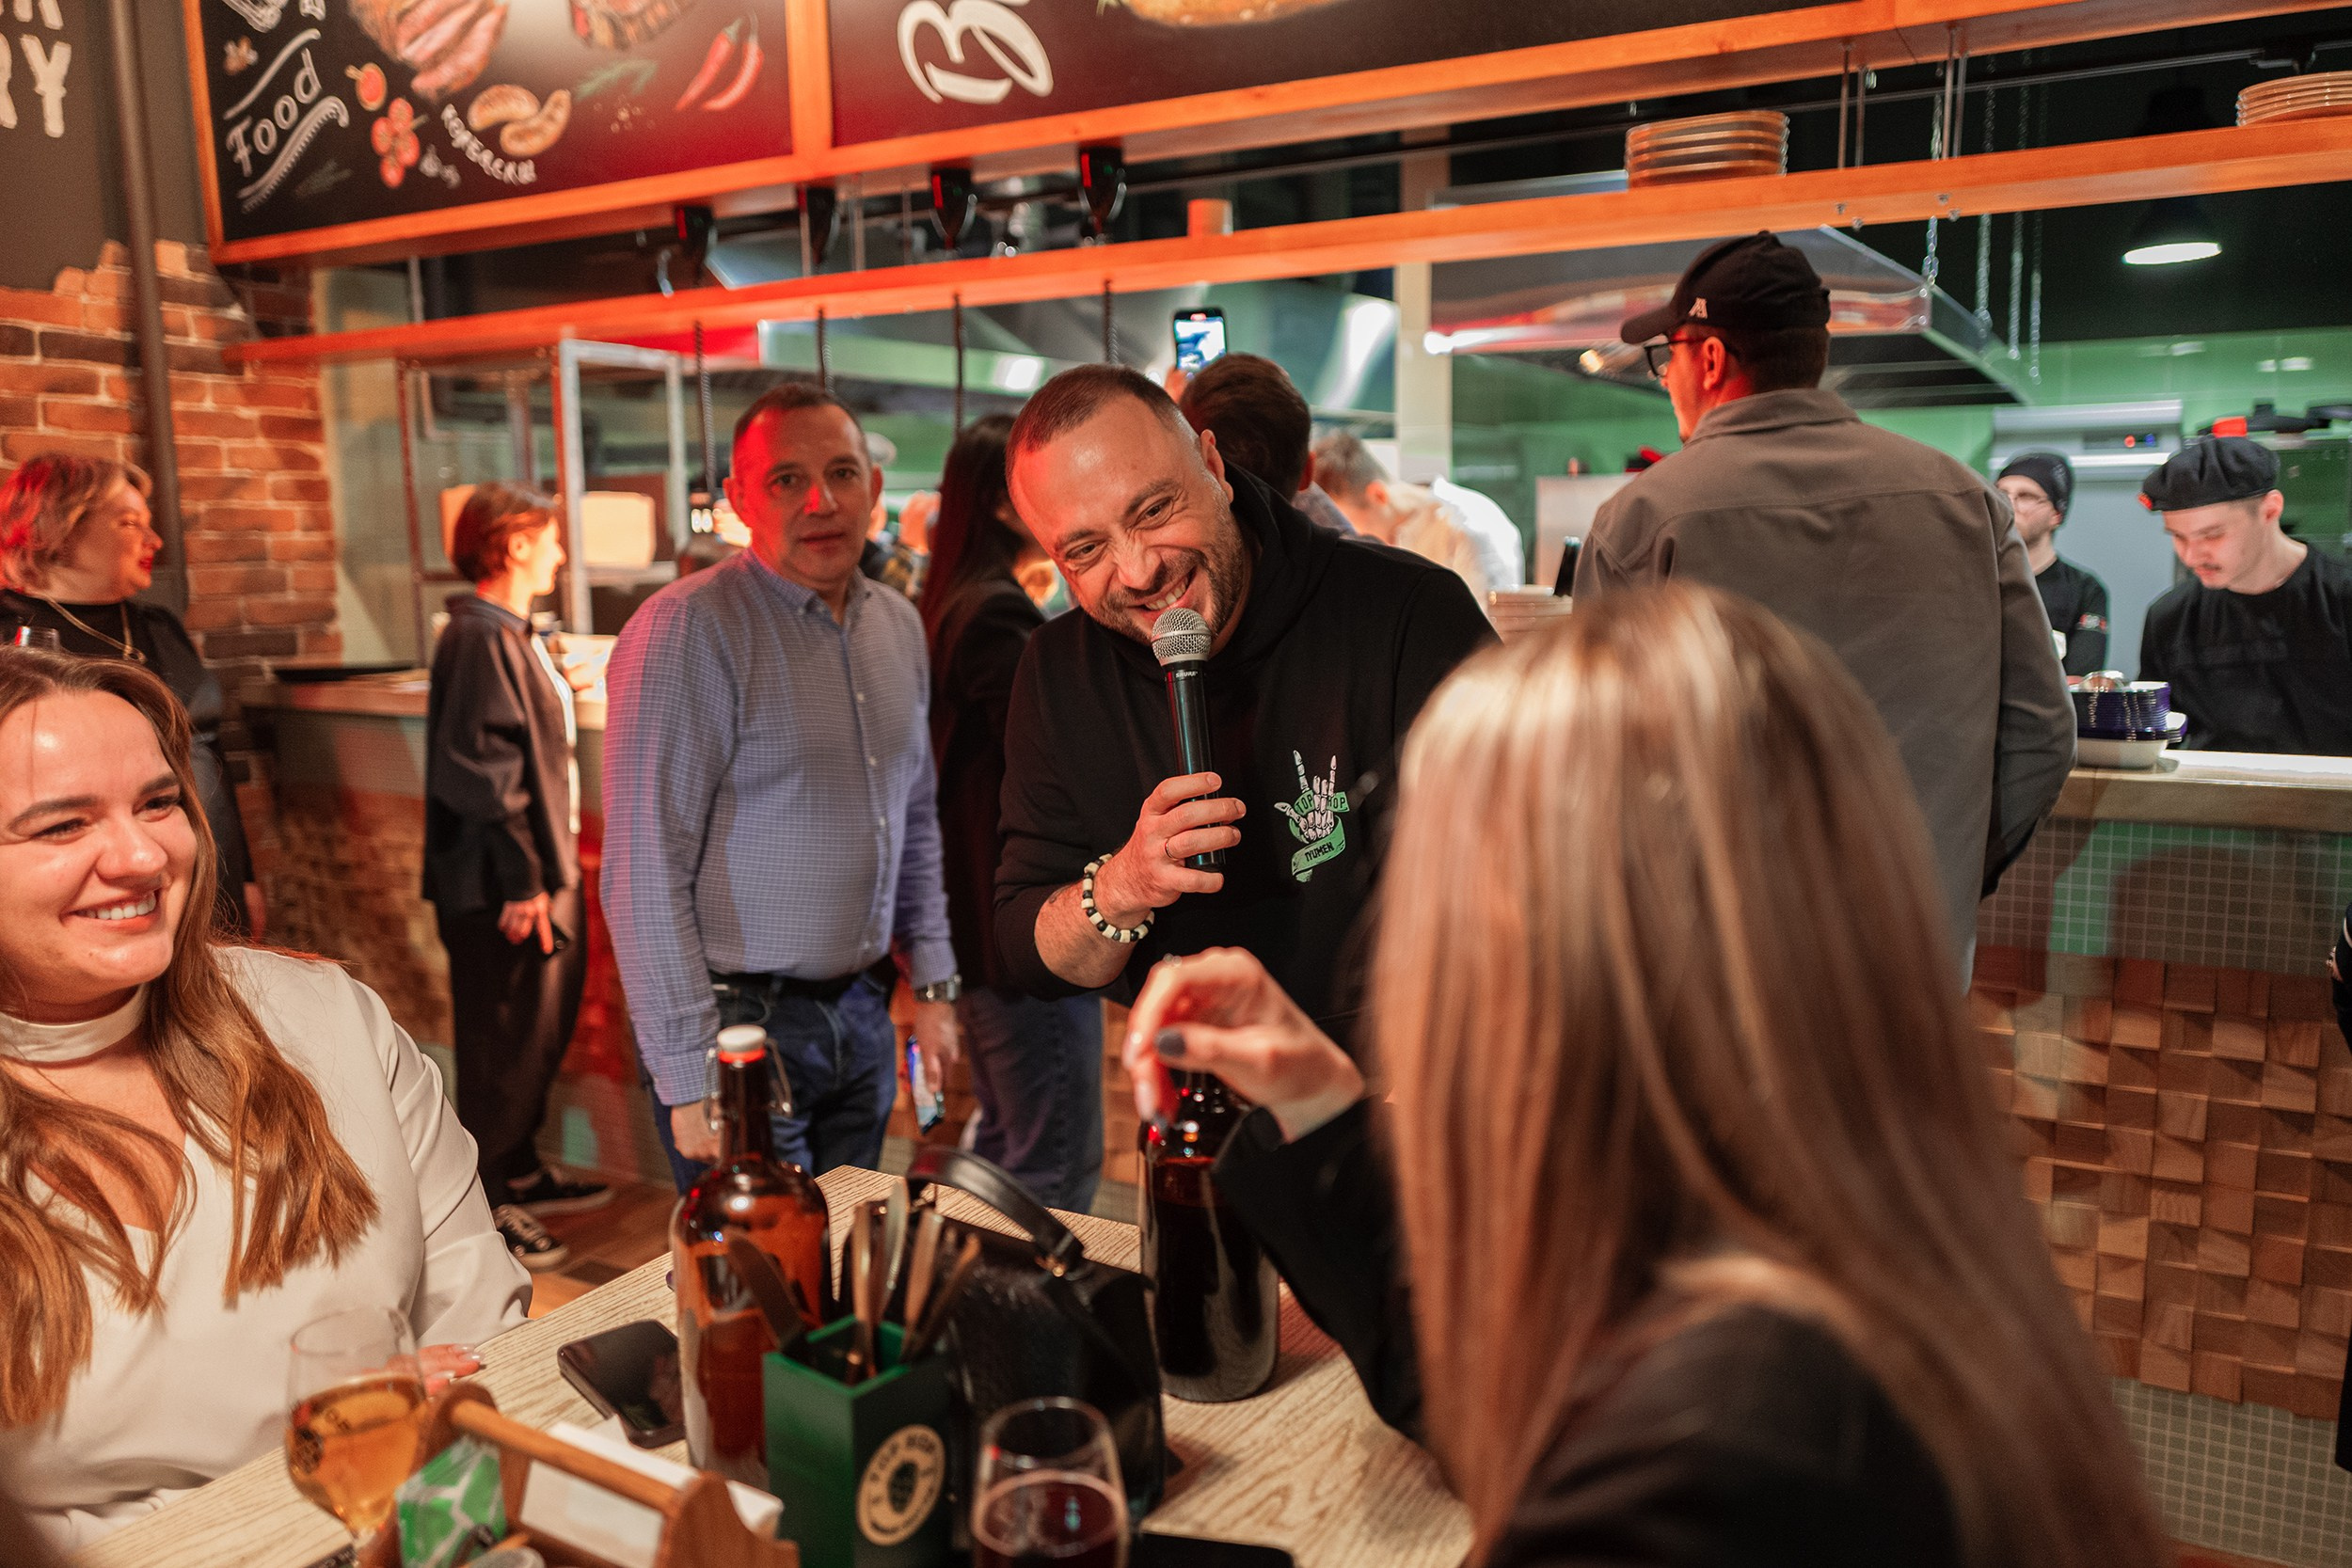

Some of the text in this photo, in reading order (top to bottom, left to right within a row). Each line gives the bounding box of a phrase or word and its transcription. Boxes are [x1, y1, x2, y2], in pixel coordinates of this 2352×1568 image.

[225, 47, 322, 177] Food
[1295, 795, 1313, 814] TOP
[1304, 842, 1334, 862] TYUMEN
